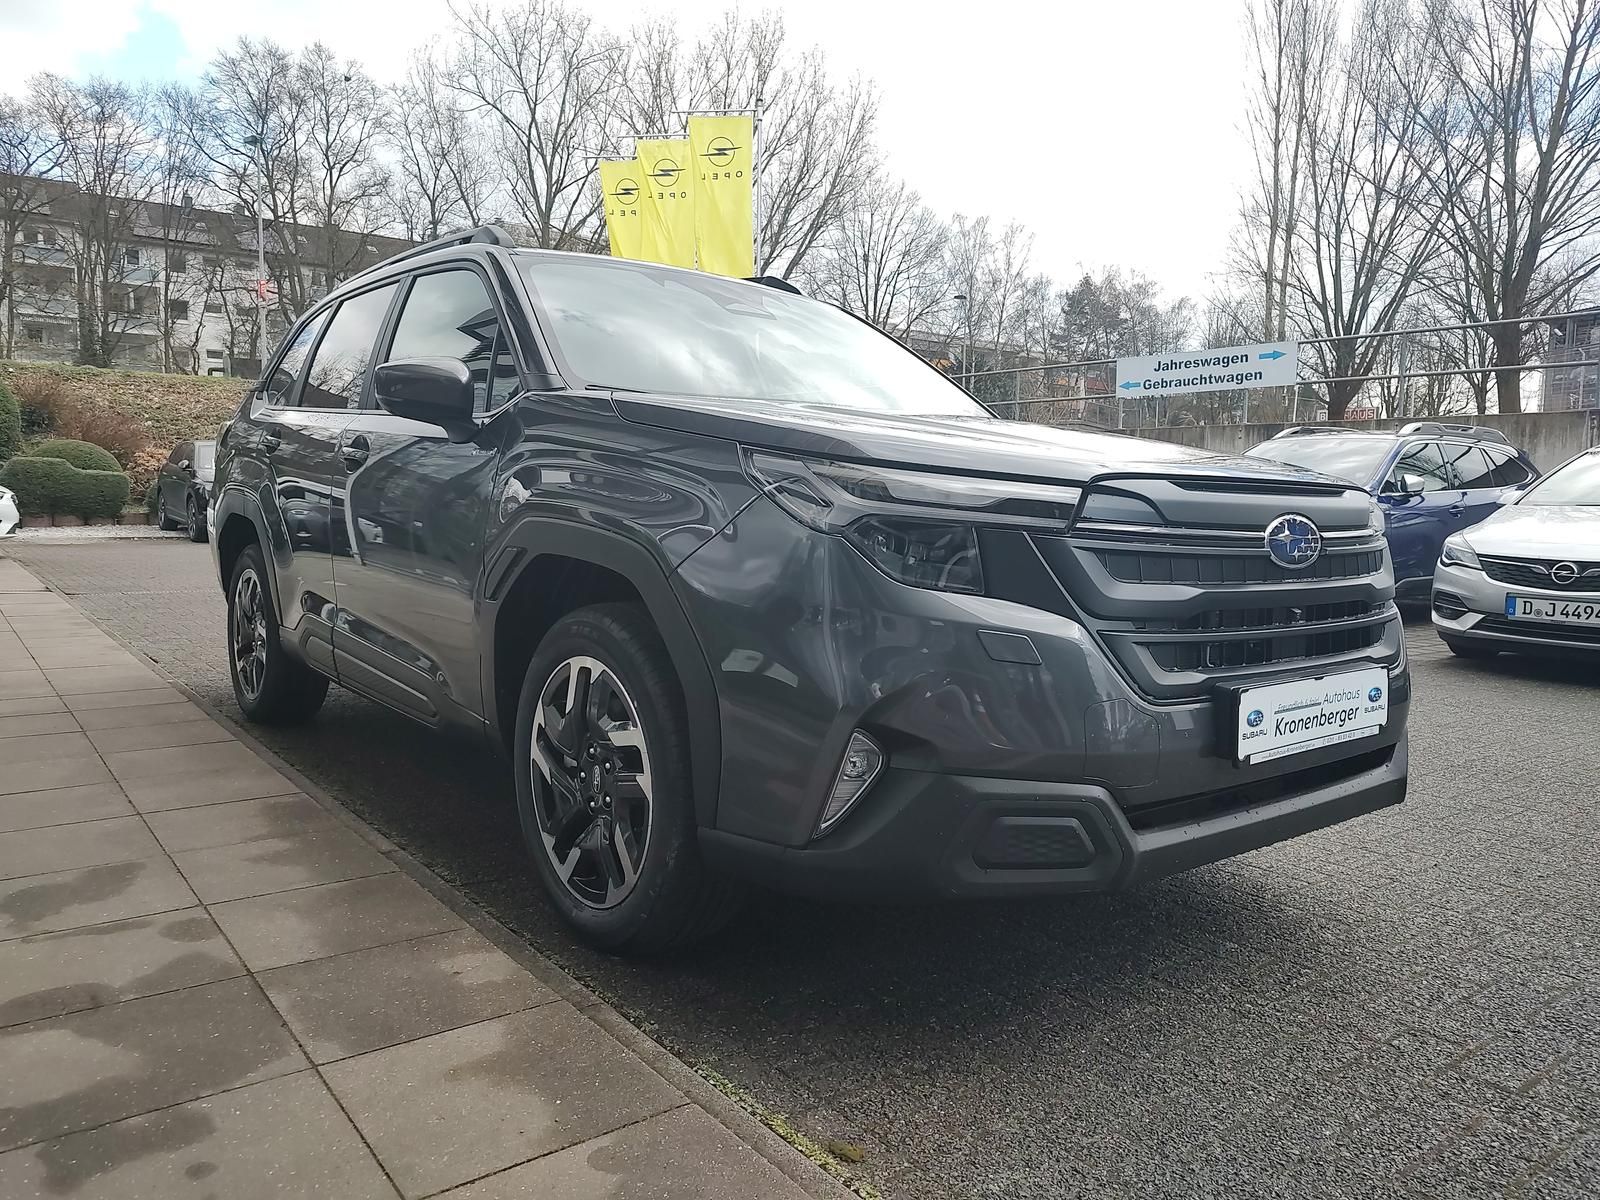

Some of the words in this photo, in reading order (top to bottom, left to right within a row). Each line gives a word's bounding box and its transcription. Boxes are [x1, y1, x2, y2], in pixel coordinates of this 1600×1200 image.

[1153, 352, 1249, 373] Jahreswagen
[1143, 370, 1263, 391] Gebrauchtwagen
[1522, 601, 1533, 615] D
[1322, 688, 1361, 706] Autohaus
[1364, 704, 1386, 714] SUBARU
[1274, 706, 1360, 738] Kronenberger
[1242, 729, 1268, 741] SUBARU
